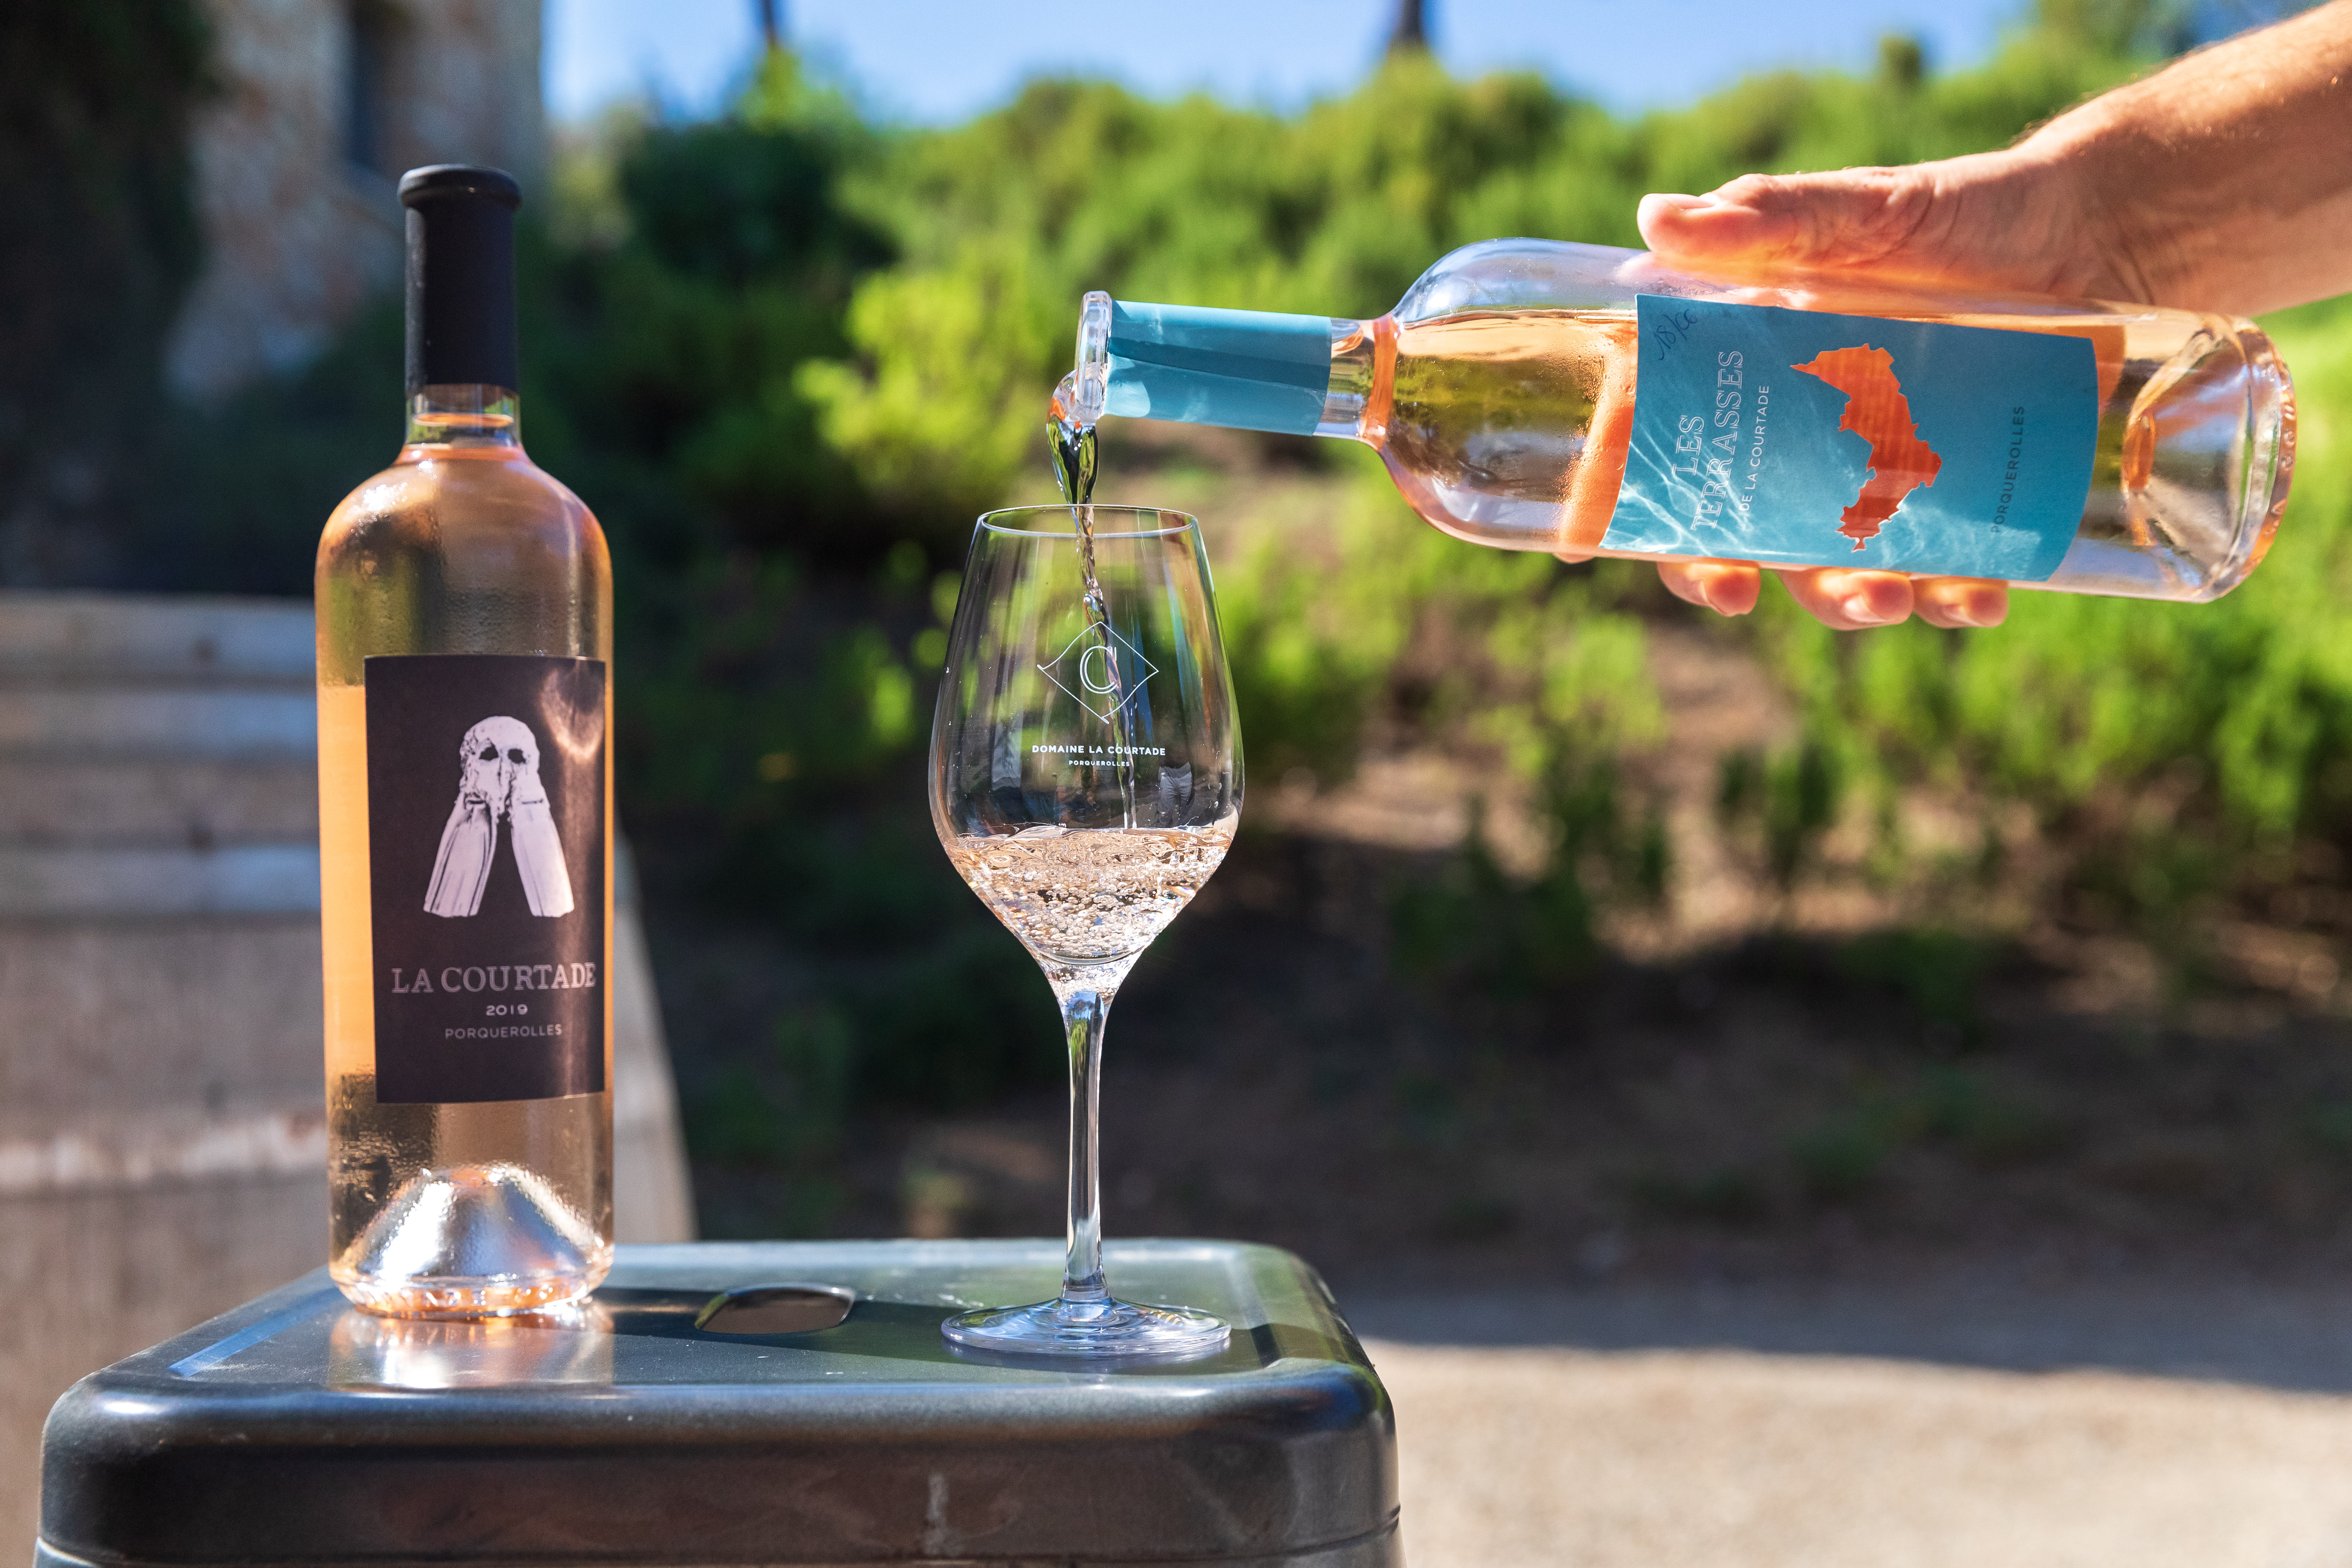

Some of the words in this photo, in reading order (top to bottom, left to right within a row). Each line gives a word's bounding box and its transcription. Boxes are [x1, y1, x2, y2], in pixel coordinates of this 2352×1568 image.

[1690, 351, 1743, 530] TERRASSES
[1750, 385, 1769, 468] COURTADE
[1672, 415, 1704, 476] LES
[1745, 473, 1758, 490] LA
[1991, 406, 2025, 533] PORQUEROLLES
[1739, 495, 1752, 511] DE
[1079, 645, 1118, 694] C
[1032, 745, 1084, 754] DOMAINE
[1089, 745, 1103, 754] LA
[1107, 746, 1166, 756] COURTADE
[392, 968, 434, 993] LA
[441, 962, 596, 992] COURTADE
[486, 1004, 528, 1016] 2019
[445, 1024, 563, 1039] PORQUEROLLES
